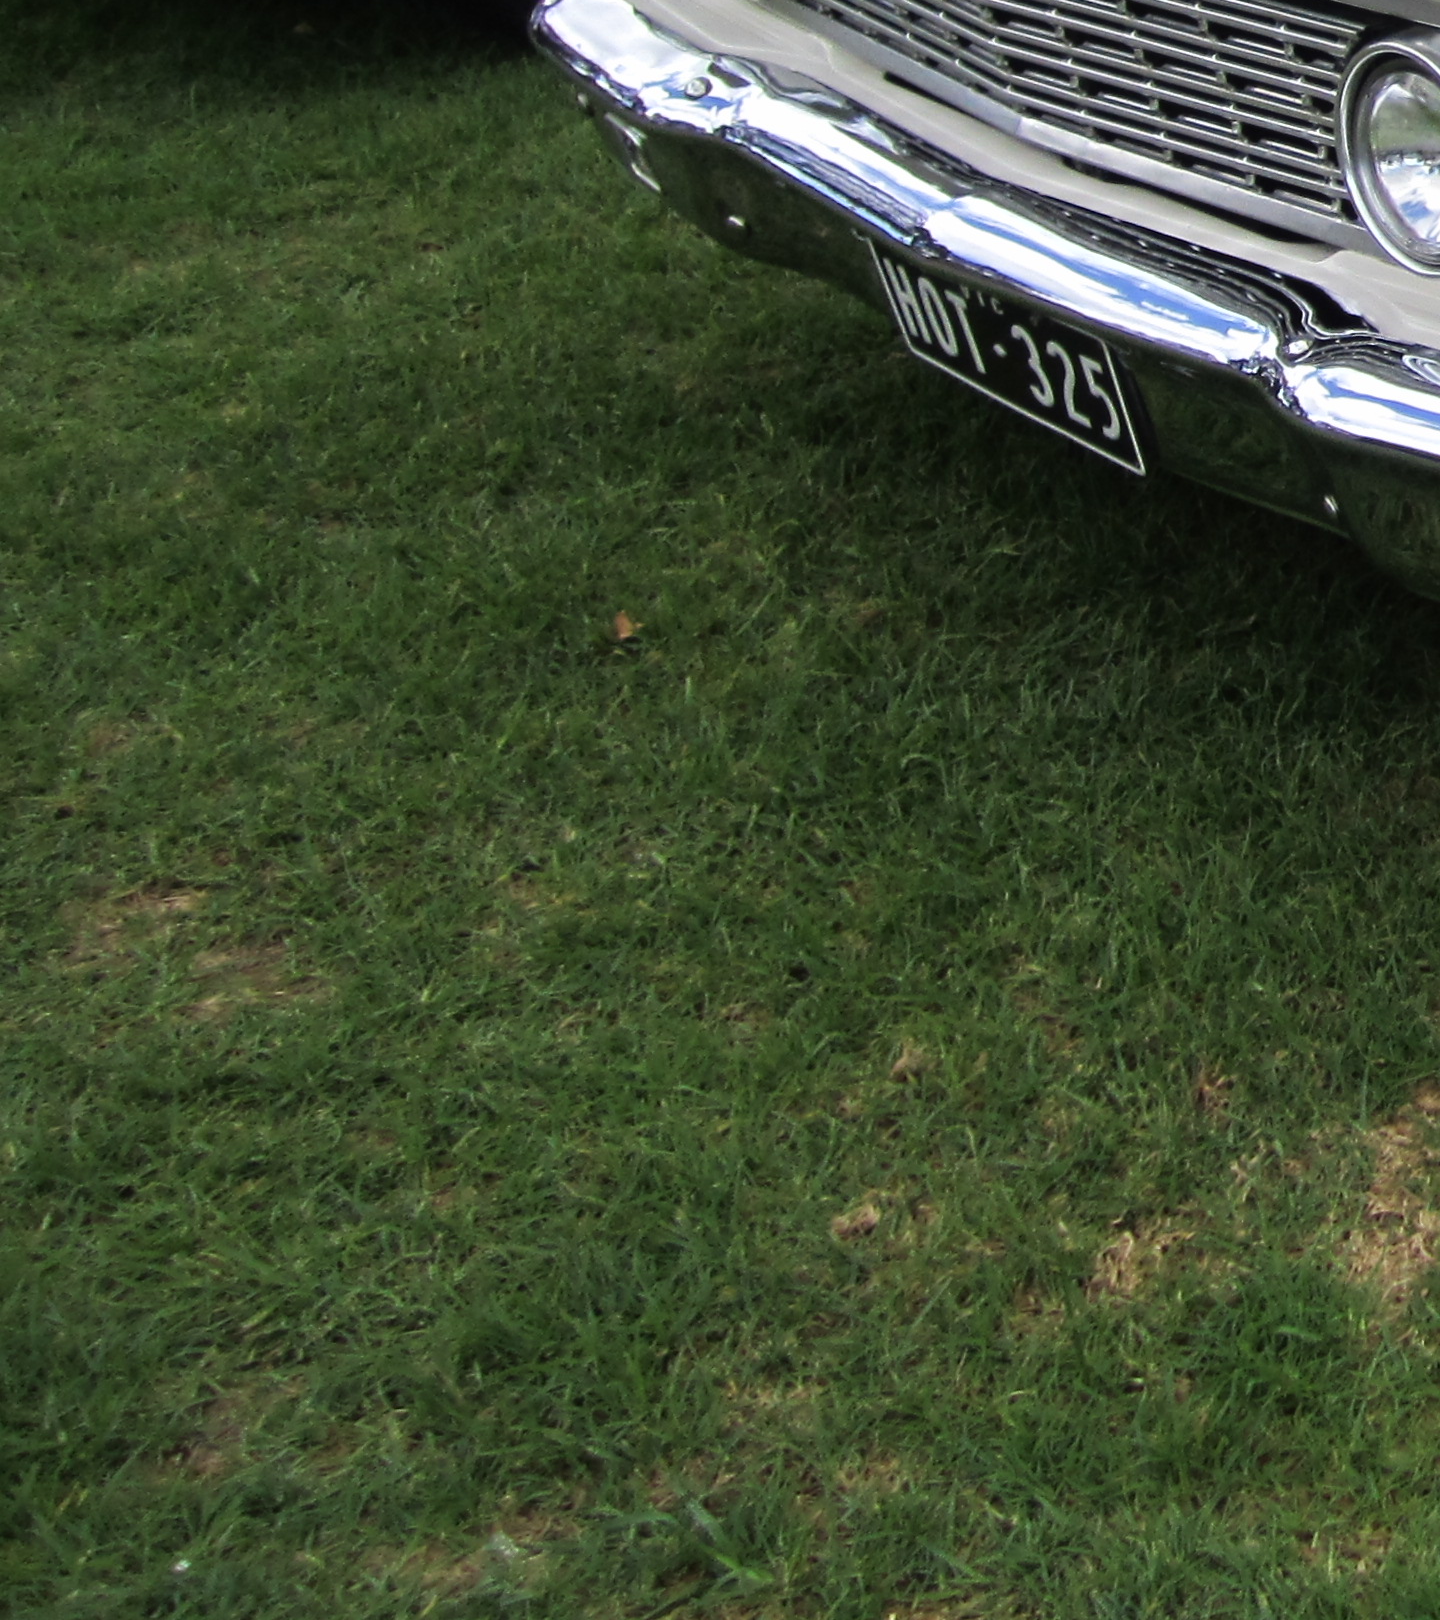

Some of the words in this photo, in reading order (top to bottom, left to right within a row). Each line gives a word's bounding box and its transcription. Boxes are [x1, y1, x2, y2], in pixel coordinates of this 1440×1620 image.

[882, 256, 987, 375] HOT
[1011, 324, 1121, 441] 325
[962, 286, 1005, 316] VIC
